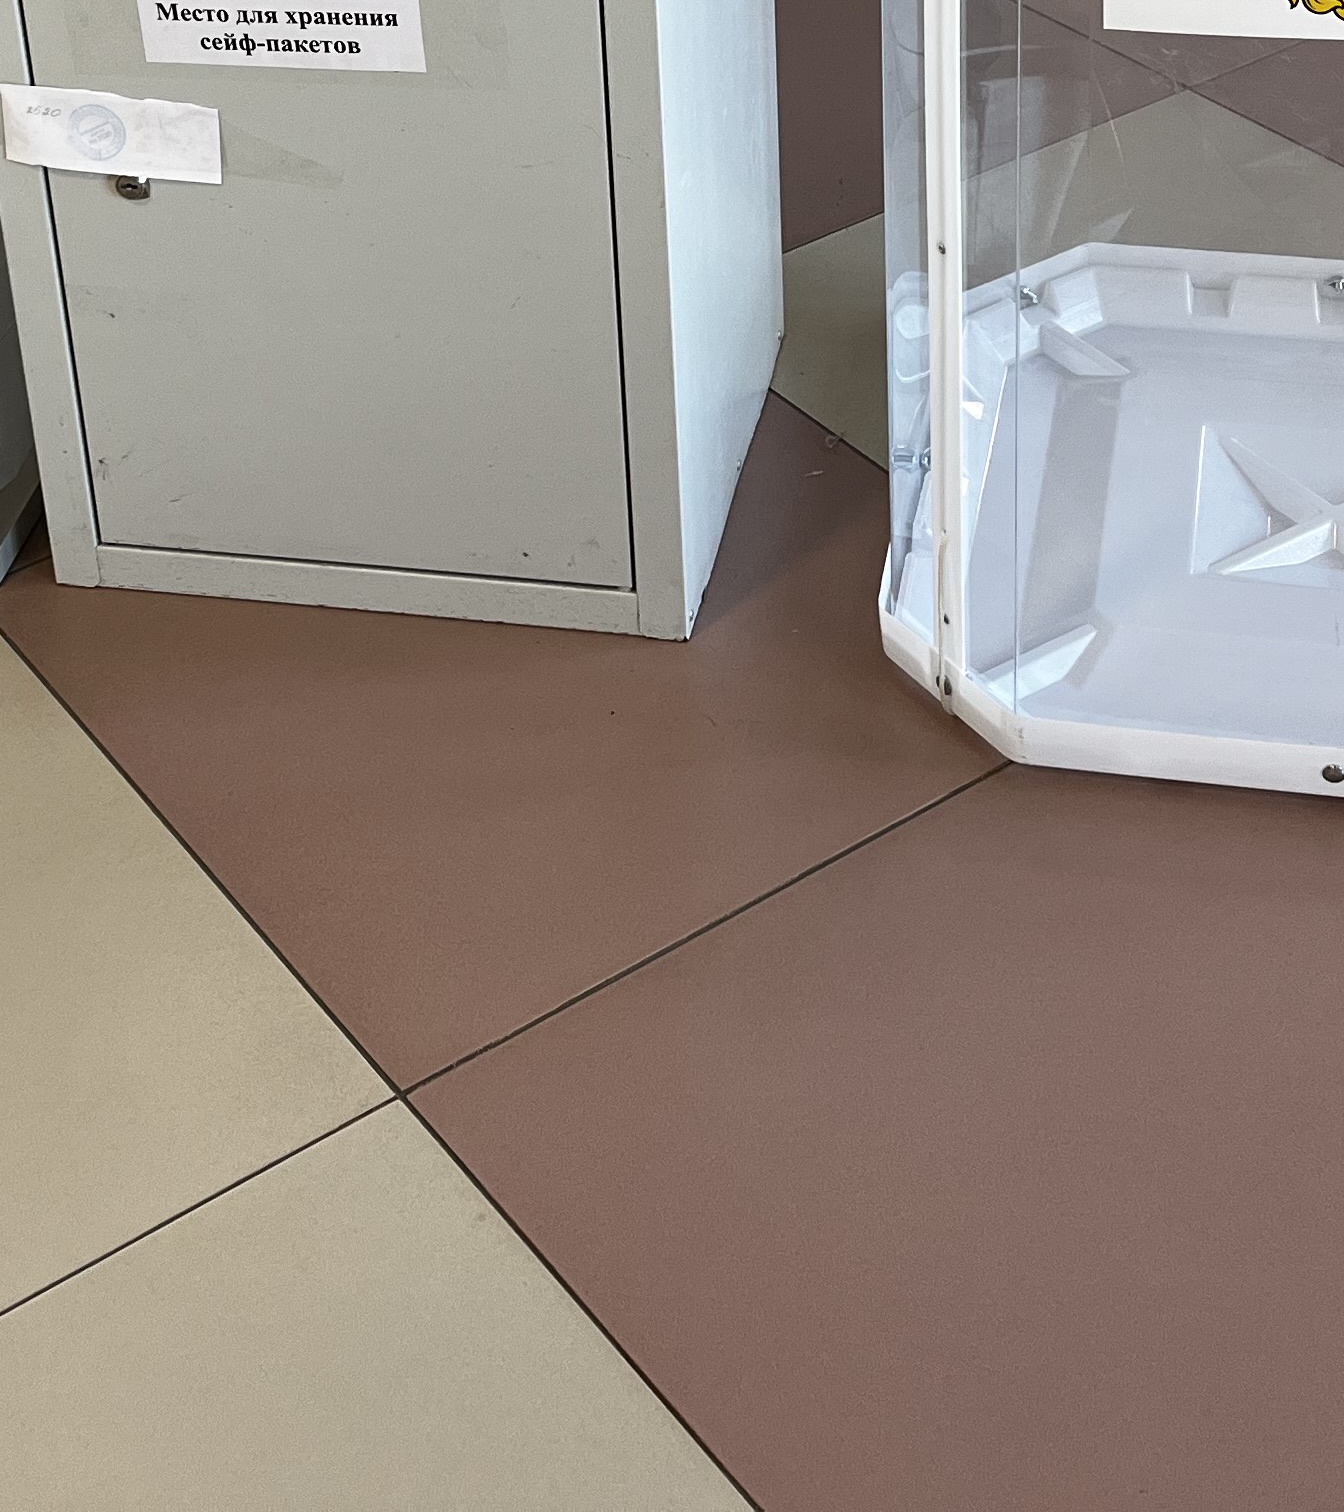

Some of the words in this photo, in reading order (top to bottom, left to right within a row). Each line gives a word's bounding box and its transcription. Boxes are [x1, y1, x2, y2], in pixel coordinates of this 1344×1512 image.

[155, 2, 229, 23] Место
[236, 9, 278, 25] для
[285, 10, 399, 29] хранения
[200, 33, 362, 56] сейф-пакетов
